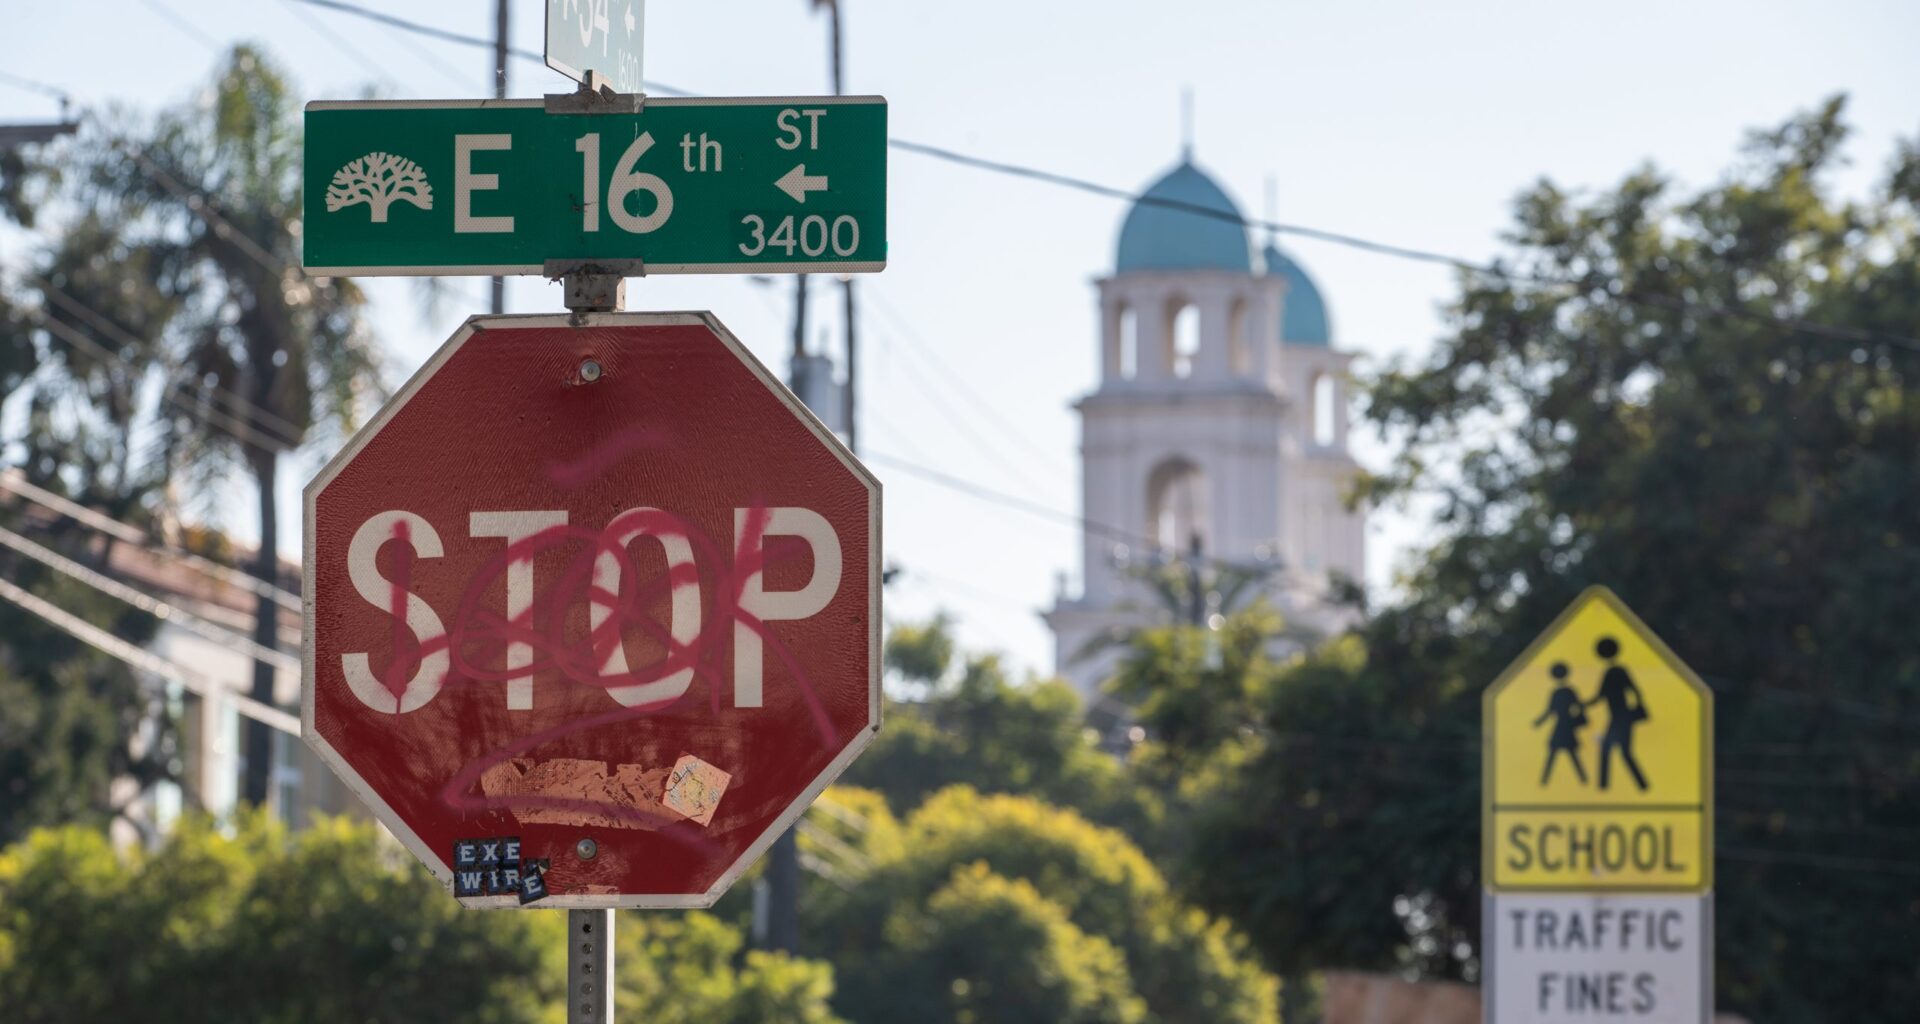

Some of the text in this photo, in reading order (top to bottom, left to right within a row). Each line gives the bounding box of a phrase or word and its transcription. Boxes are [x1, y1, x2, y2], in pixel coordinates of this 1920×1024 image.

[775, 109, 827, 150] ST
[454, 133, 515, 234] E
[738, 214, 860, 258] 3400
[341, 506, 843, 714] STOP
[460, 843, 521, 862] EXE
[1507, 823, 1688, 872] SCHOOL
[461, 869, 543, 895] WIRE
[1509, 909, 1684, 951] TRAFFIC
[1538, 971, 1657, 1014] FINES
